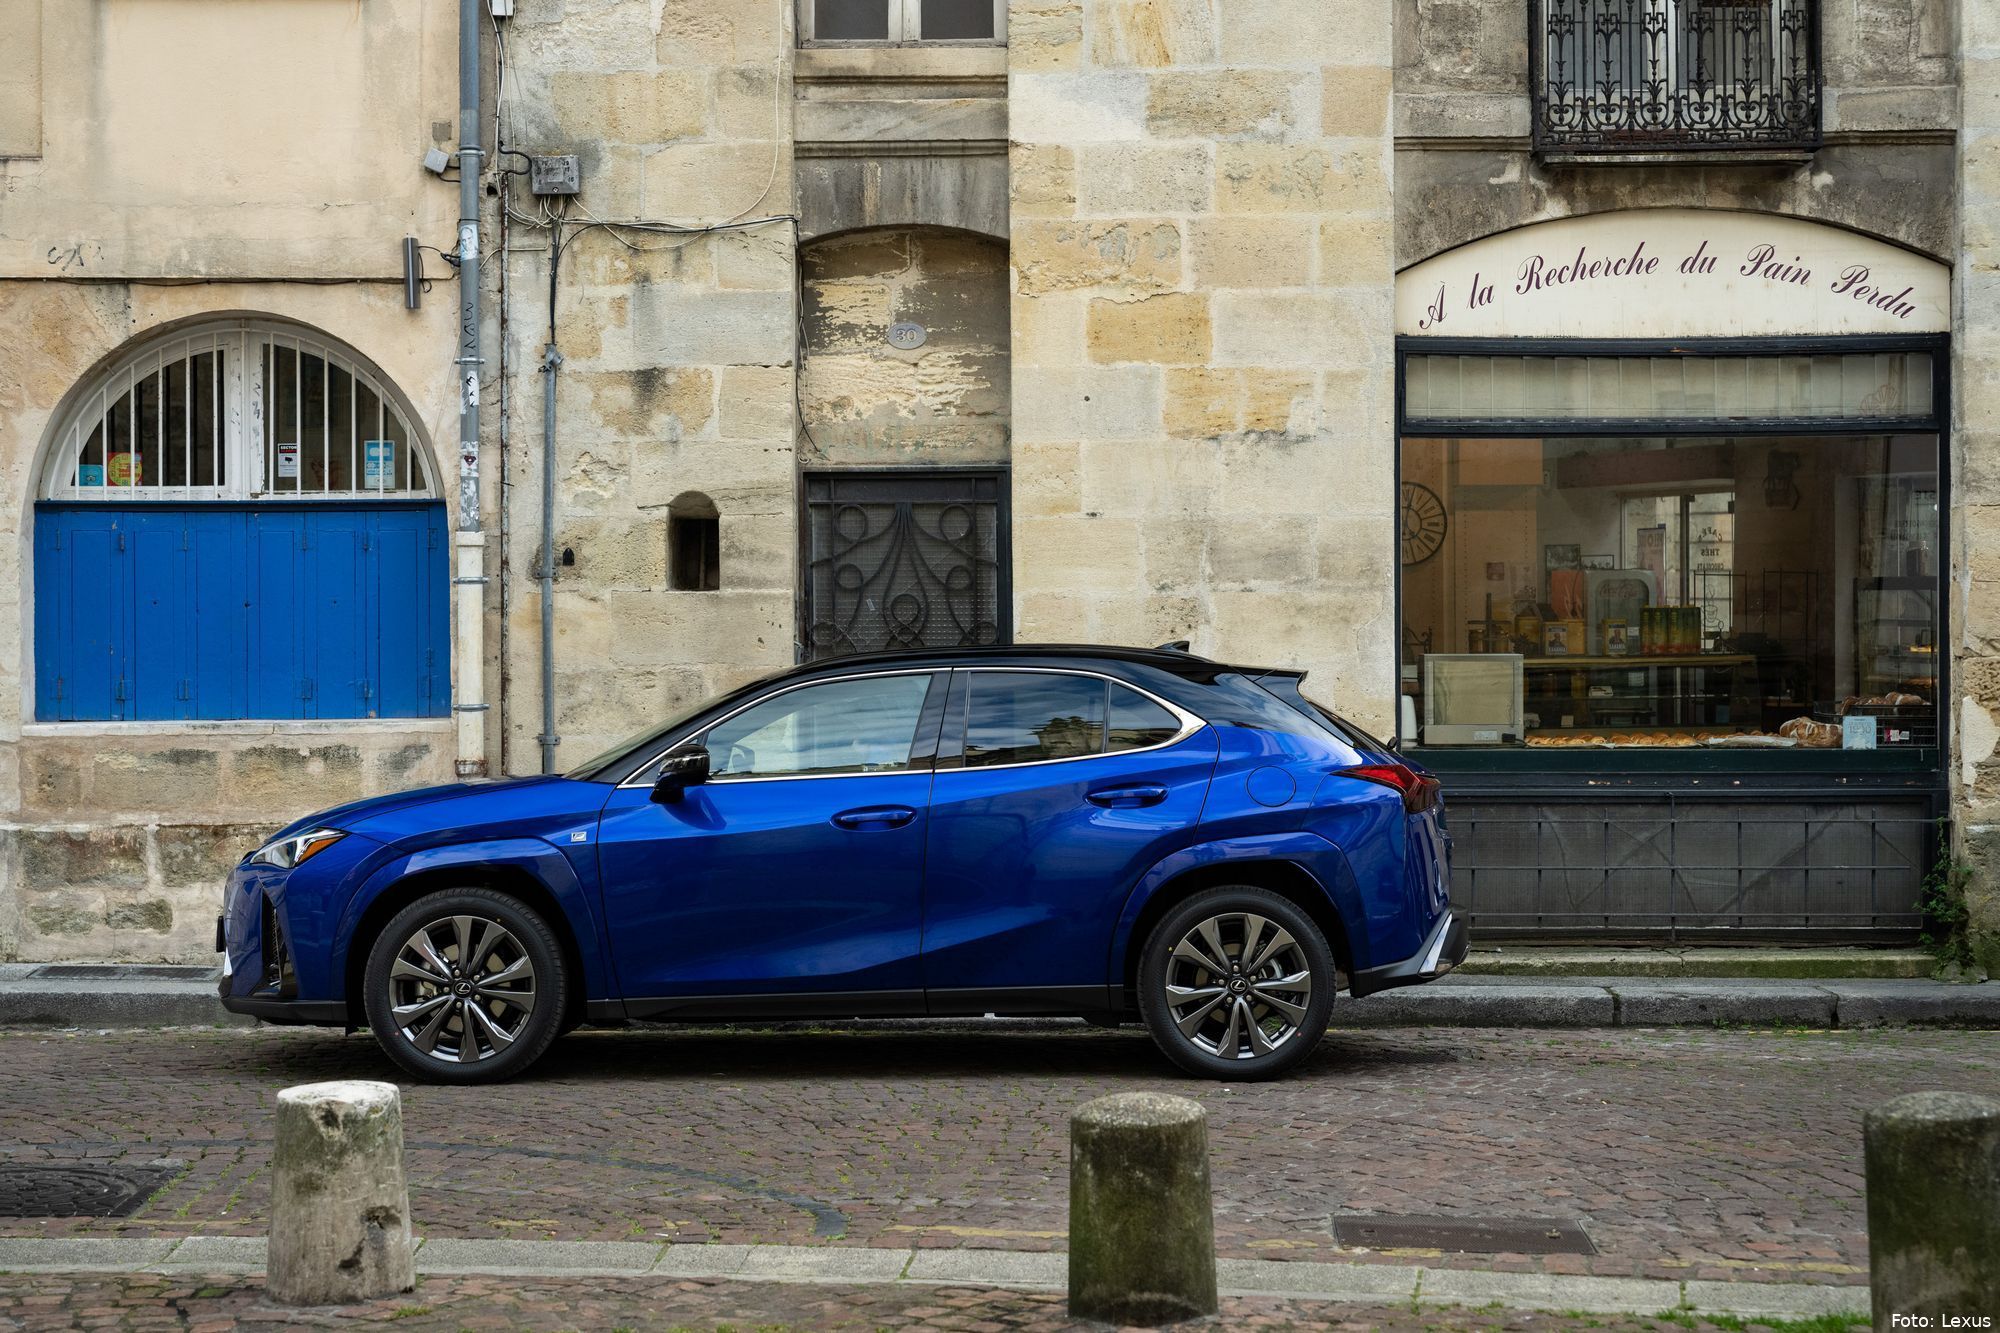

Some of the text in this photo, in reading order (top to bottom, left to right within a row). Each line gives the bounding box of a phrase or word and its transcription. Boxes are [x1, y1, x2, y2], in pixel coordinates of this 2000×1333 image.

[1467, 273, 1495, 310] la
[1516, 240, 1660, 296] Recherche
[1676, 240, 1718, 275] du
[1740, 243, 1811, 286] Pain
[1831, 264, 1917, 320] Perdu
[895, 328, 918, 342] 30
